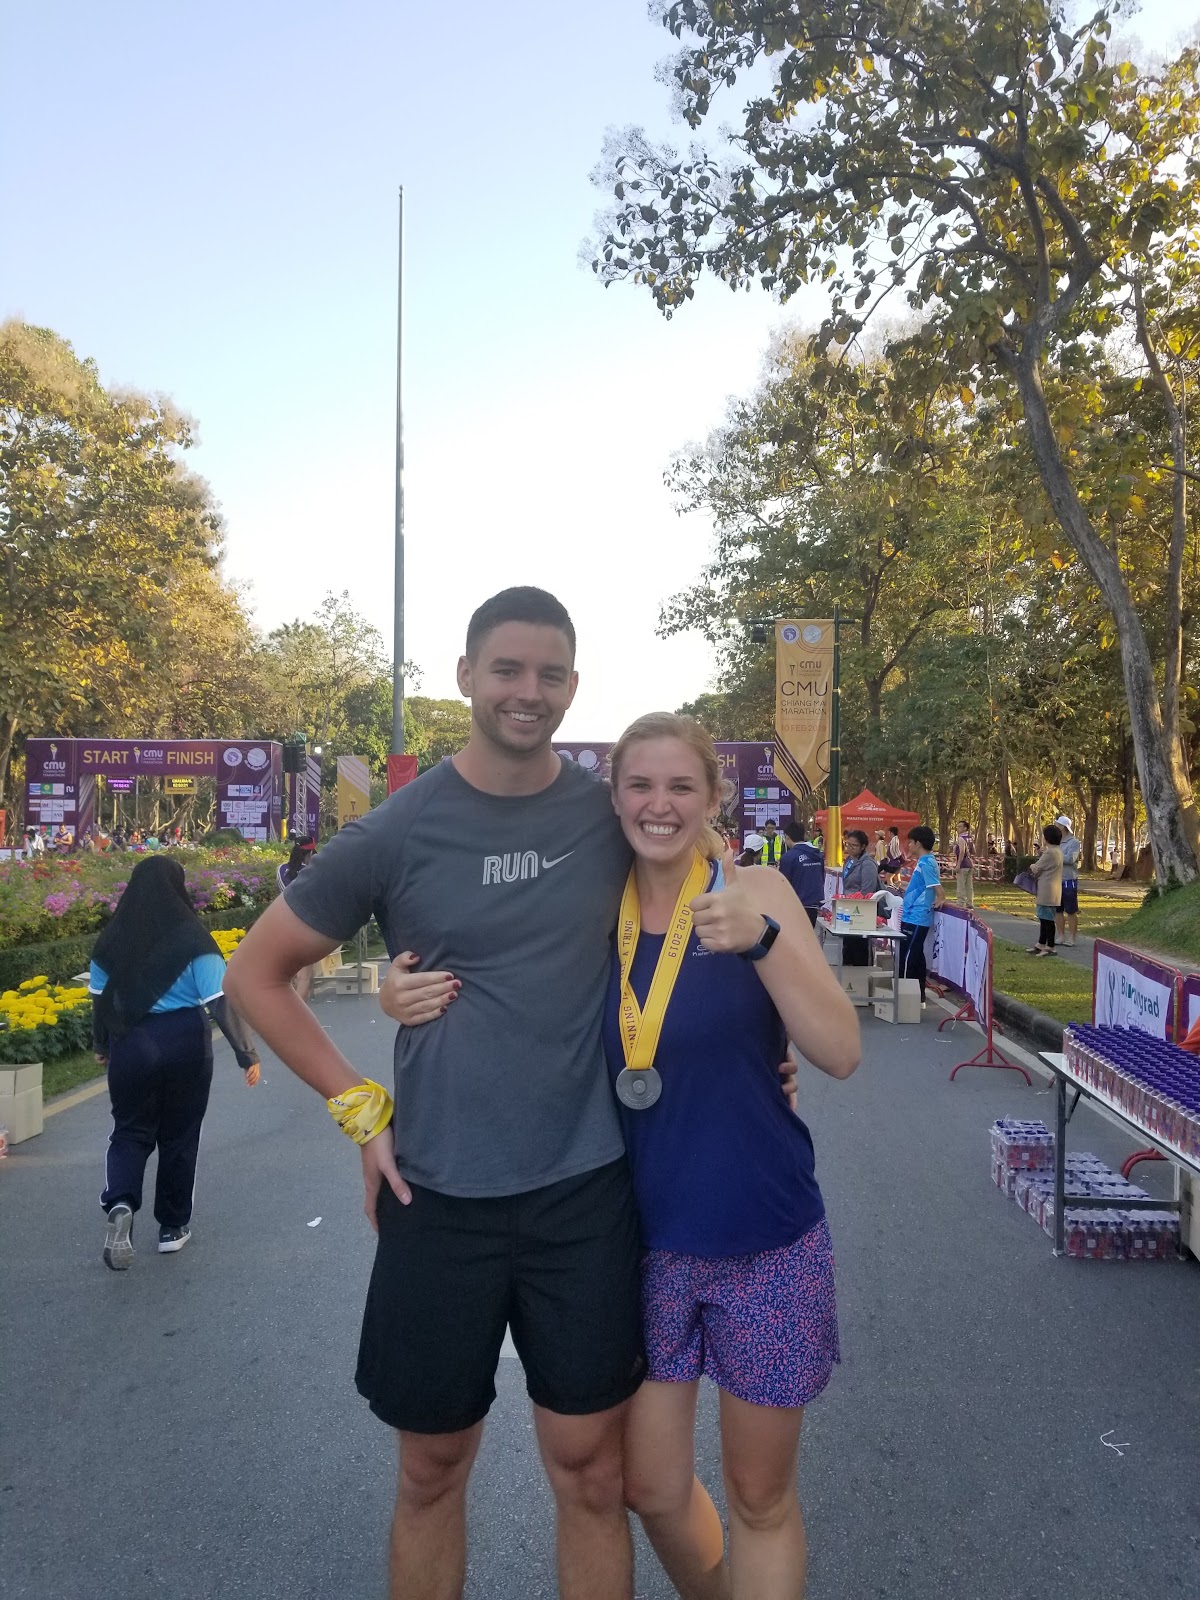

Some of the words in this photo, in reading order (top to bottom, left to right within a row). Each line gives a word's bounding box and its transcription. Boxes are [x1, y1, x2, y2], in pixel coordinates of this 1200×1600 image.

[800, 661, 822, 669] cmu
[781, 681, 828, 696] CMU
[781, 699, 812, 707] CHIANG
[781, 707, 827, 715] MARATHON
[791, 724, 807, 732] FEB
[83, 750, 130, 764] START
[143, 749, 163, 757] cmu
[167, 751, 214, 765] FINISH
[43, 761, 66, 769] cmu
[757, 765, 774, 774] cm
[342, 814, 362, 823] cm
[482, 850, 539, 885] RUN
[622, 920, 634, 947] THING
